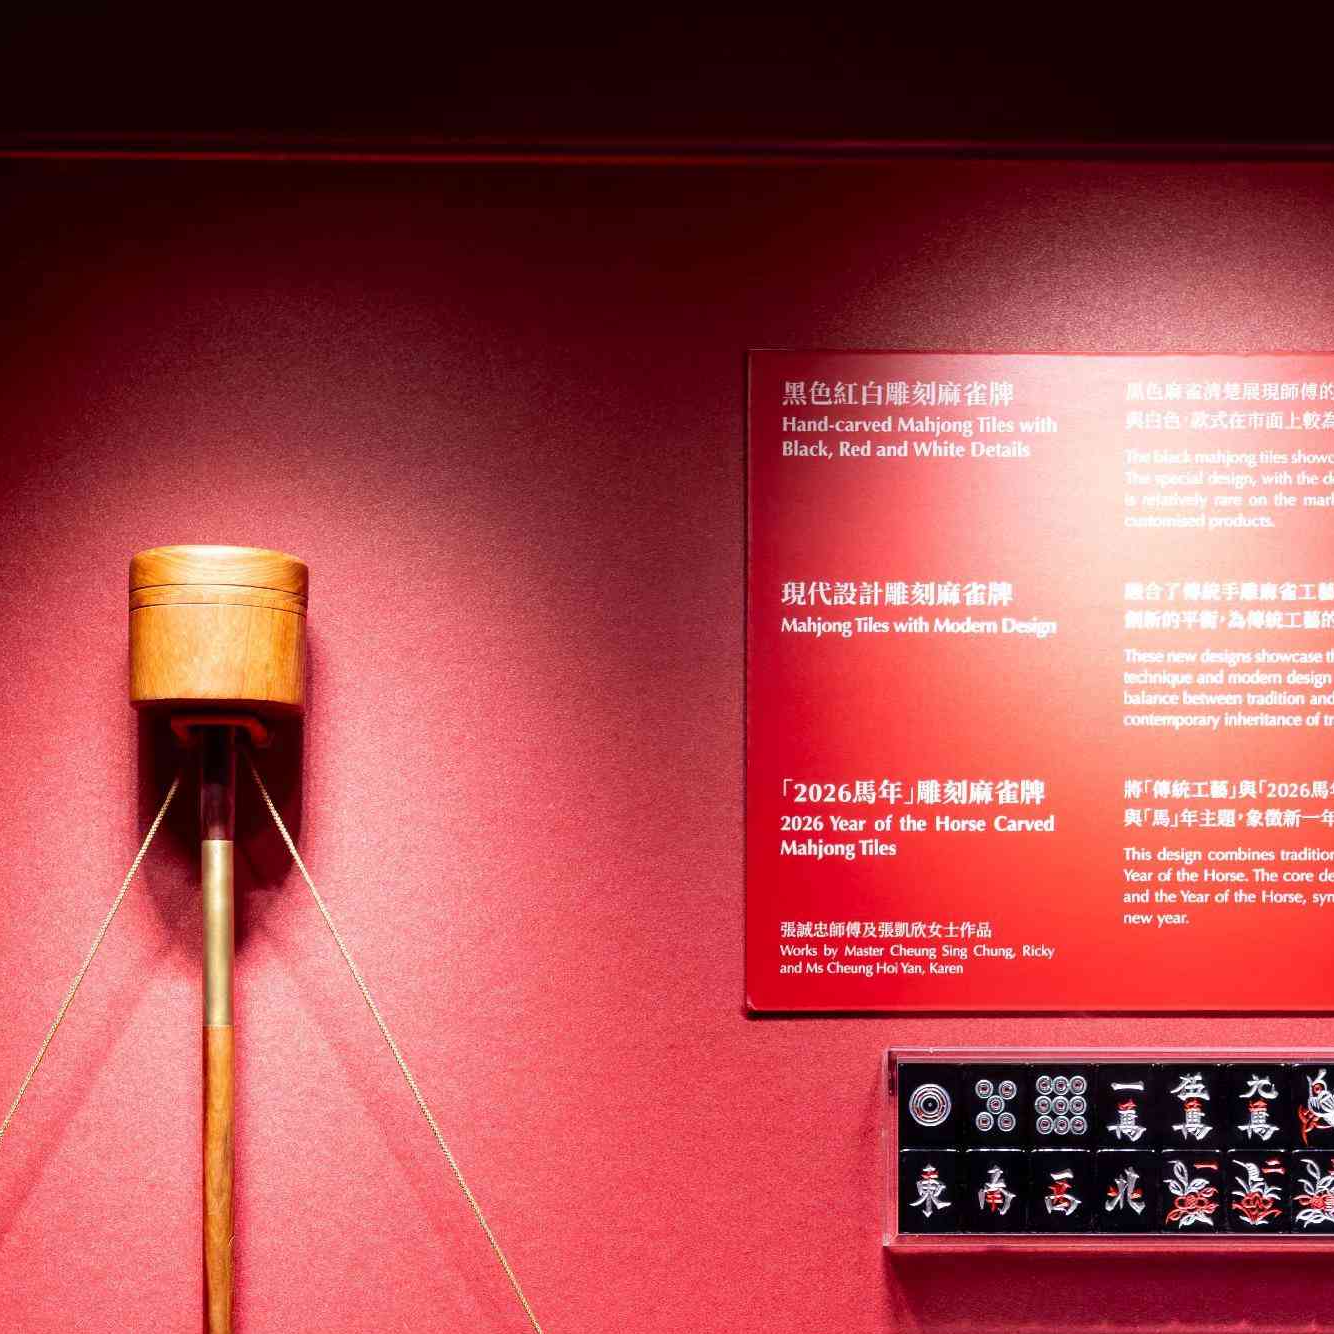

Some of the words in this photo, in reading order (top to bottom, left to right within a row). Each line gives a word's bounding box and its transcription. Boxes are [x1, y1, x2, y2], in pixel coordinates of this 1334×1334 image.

[782, 380, 1015, 406] 黑色紅白雕刻麻雀牌
[782, 416, 893, 433] Hand-carved
[897, 416, 974, 437] Mahjong
[978, 416, 1015, 433] Tiles
[1019, 416, 1059, 433] with
[782, 440, 833, 460] Black,
[839, 440, 872, 457] Red
[876, 440, 909, 457] and
[913, 440, 966, 457] White
[970, 440, 1032, 457] Details
[781, 581, 1013, 606] 現代設計雕刻麻雀牌
[781, 617, 853, 638] Mahjong
[856, 617, 890, 633] Tiles
[893, 617, 930, 633] with
[933, 617, 999, 633] Modern
[1001, 617, 1058, 638] Design
[782, 779, 1045, 805] 「2026馬年」雕刻麻雀牌
[780, 815, 824, 832] 2026
[830, 815, 866, 832] Year
[874, 815, 893, 832] of
[899, 815, 927, 832] the
[935, 815, 987, 832] Horse
[993, 815, 1056, 832] Carved
[780, 839, 856, 860] Mahjong
[861, 839, 897, 856] Tiles
[1124, 847, 1152, 860] This
[1156, 847, 1203, 864] design
[1207, 847, 1276, 860] combines
[1122, 868, 1153, 882] Year
[1157, 868, 1173, 882] of
[1176, 868, 1199, 882] the
[1202, 868, 1249, 882] Horse.
[1252, 868, 1279, 882] The
[1282, 871, 1314, 882] core
[1123, 890, 1151, 904] and
[1154, 890, 1177, 904] the
[1180, 890, 1210, 904] Year
[1214, 890, 1230, 904] of
[1233, 890, 1257, 904] the
[1261, 890, 1307, 907] Horse,
[1123, 913, 1153, 924] new
[1157, 913, 1191, 927] year.
[779, 943, 818, 957] Works
[823, 943, 838, 960] by
[844, 943, 883, 957] Master
[889, 943, 937, 960] Cheung
[941, 943, 969, 960] Sing
[972, 943, 1016, 960] Chung,
[1022, 943, 1055, 960] Ricky
[779, 961, 803, 974] and
[805, 961, 824, 974] Ms
[826, 961, 874, 977] Cheung
[875, 961, 899, 974] Hoi
[901, 961, 926, 977] Yan,
[929, 961, 964, 974] Karen
